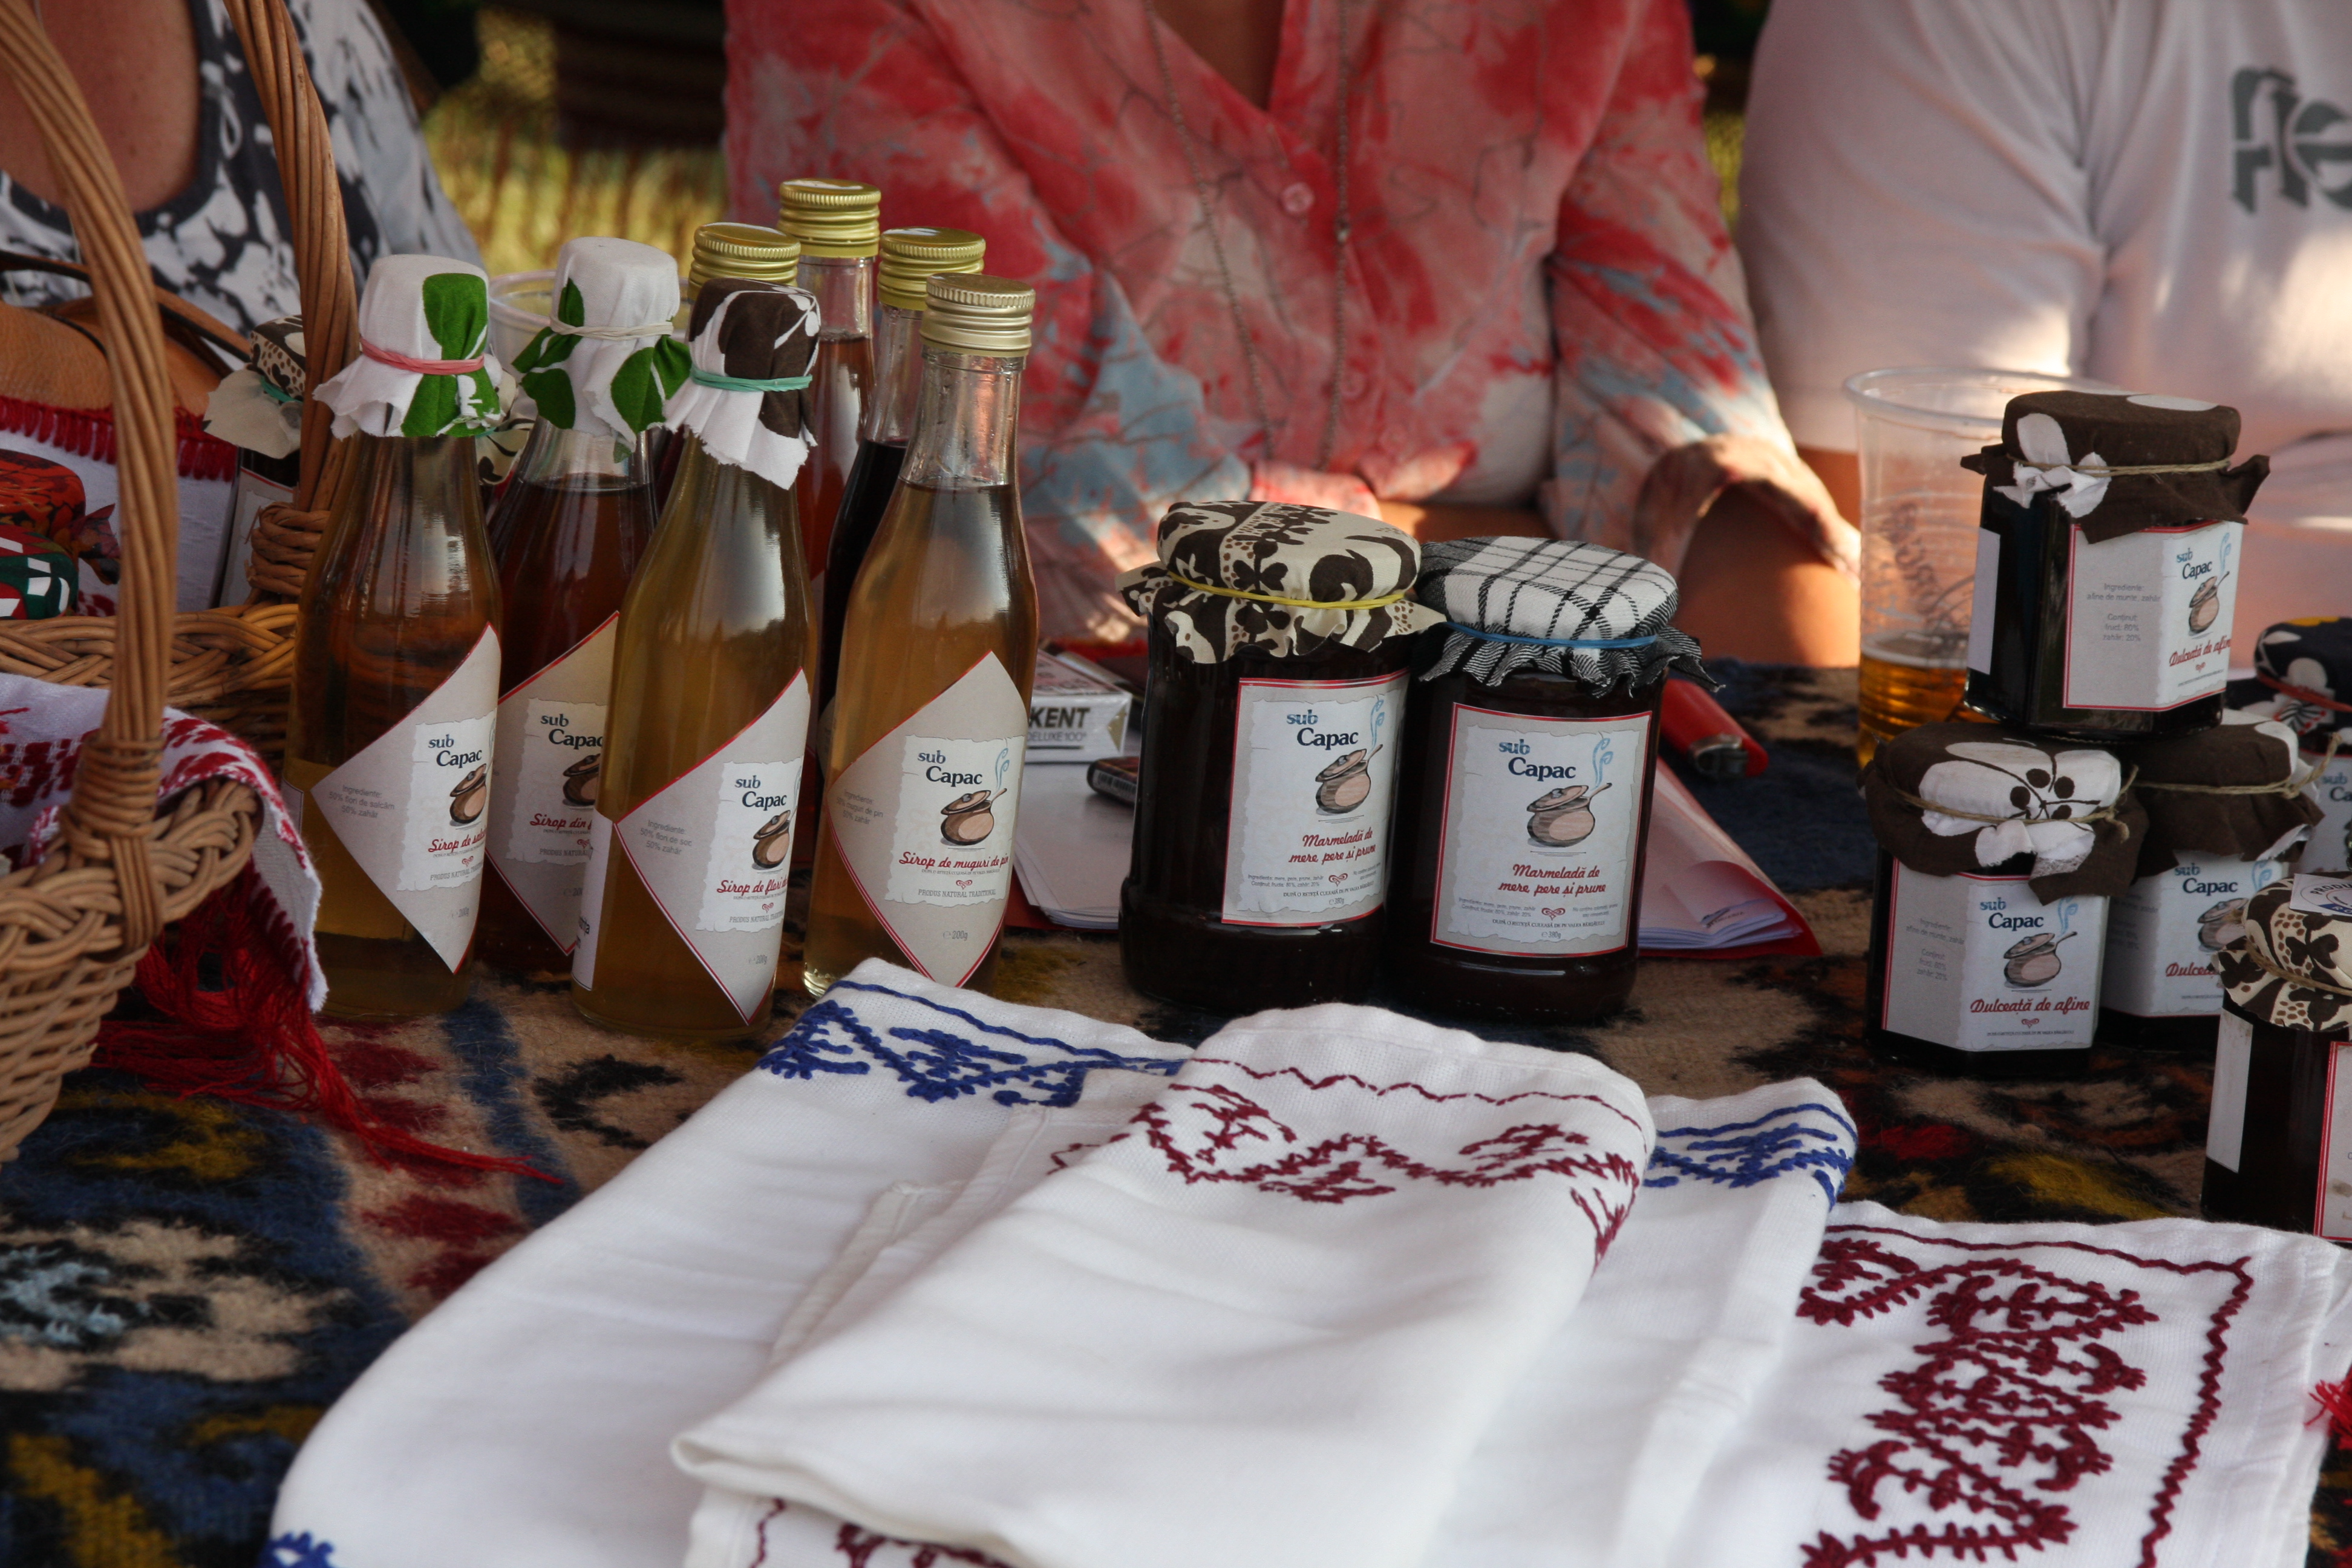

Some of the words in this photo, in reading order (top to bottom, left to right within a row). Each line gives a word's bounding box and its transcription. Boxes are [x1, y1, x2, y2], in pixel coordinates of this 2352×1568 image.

[2177, 547, 2193, 563] sub
[2182, 561, 2213, 580] Capac
[2203, 640, 2213, 655] de
[540, 713, 569, 727] sub
[1028, 707, 1091, 728] KENT
[1286, 709, 1318, 725] sub
[428, 734, 454, 748] sub
[548, 728, 603, 750] Capac
[1297, 727, 1359, 751] Capac
[1498, 739, 1530, 755] sub
[436, 750, 482, 769] Capac
[917, 750, 946, 764] sub
[926, 765, 983, 787] Capac
[1508, 757, 1576, 782] Capac
[734, 775, 761, 789] sub
[742, 791, 788, 811] Capac
[529, 813, 566, 831] Sirop
[569, 818, 587, 828] din
[428, 838, 460, 853] Sirop
[460, 834, 471, 848] de
[1302, 829, 1363, 847] Marmeladă
[1364, 826, 1373, 840] de
[899, 851, 936, 869] Sirop
[938, 857, 951, 867] de
[953, 856, 990, 871] muguri
[991, 855, 1000, 867] de
[1289, 854, 1319, 863] mere
[1321, 852, 1344, 866] pere
[1354, 844, 1376, 861] prune
[1512, 864, 1587, 878] Marmeladă
[1587, 865, 1600, 878] de
[2175, 863, 2200, 876] sub
[717, 880, 751, 896] Sirop
[752, 880, 764, 893] de
[765, 877, 783, 895] flori
[918, 889, 941, 897] PRODUS
[1534, 884, 1560, 897] pere
[1575, 884, 1606, 897] prune
[2183, 878, 2238, 896] Capac
[1980, 897, 2007, 910] sub
[1988, 912, 2044, 931] Capac
[952, 930, 968, 941] 200g
[1970, 998, 2033, 1014] Dulceață
[2034, 997, 2051, 1011] de
[2054, 997, 2090, 1014] afine
